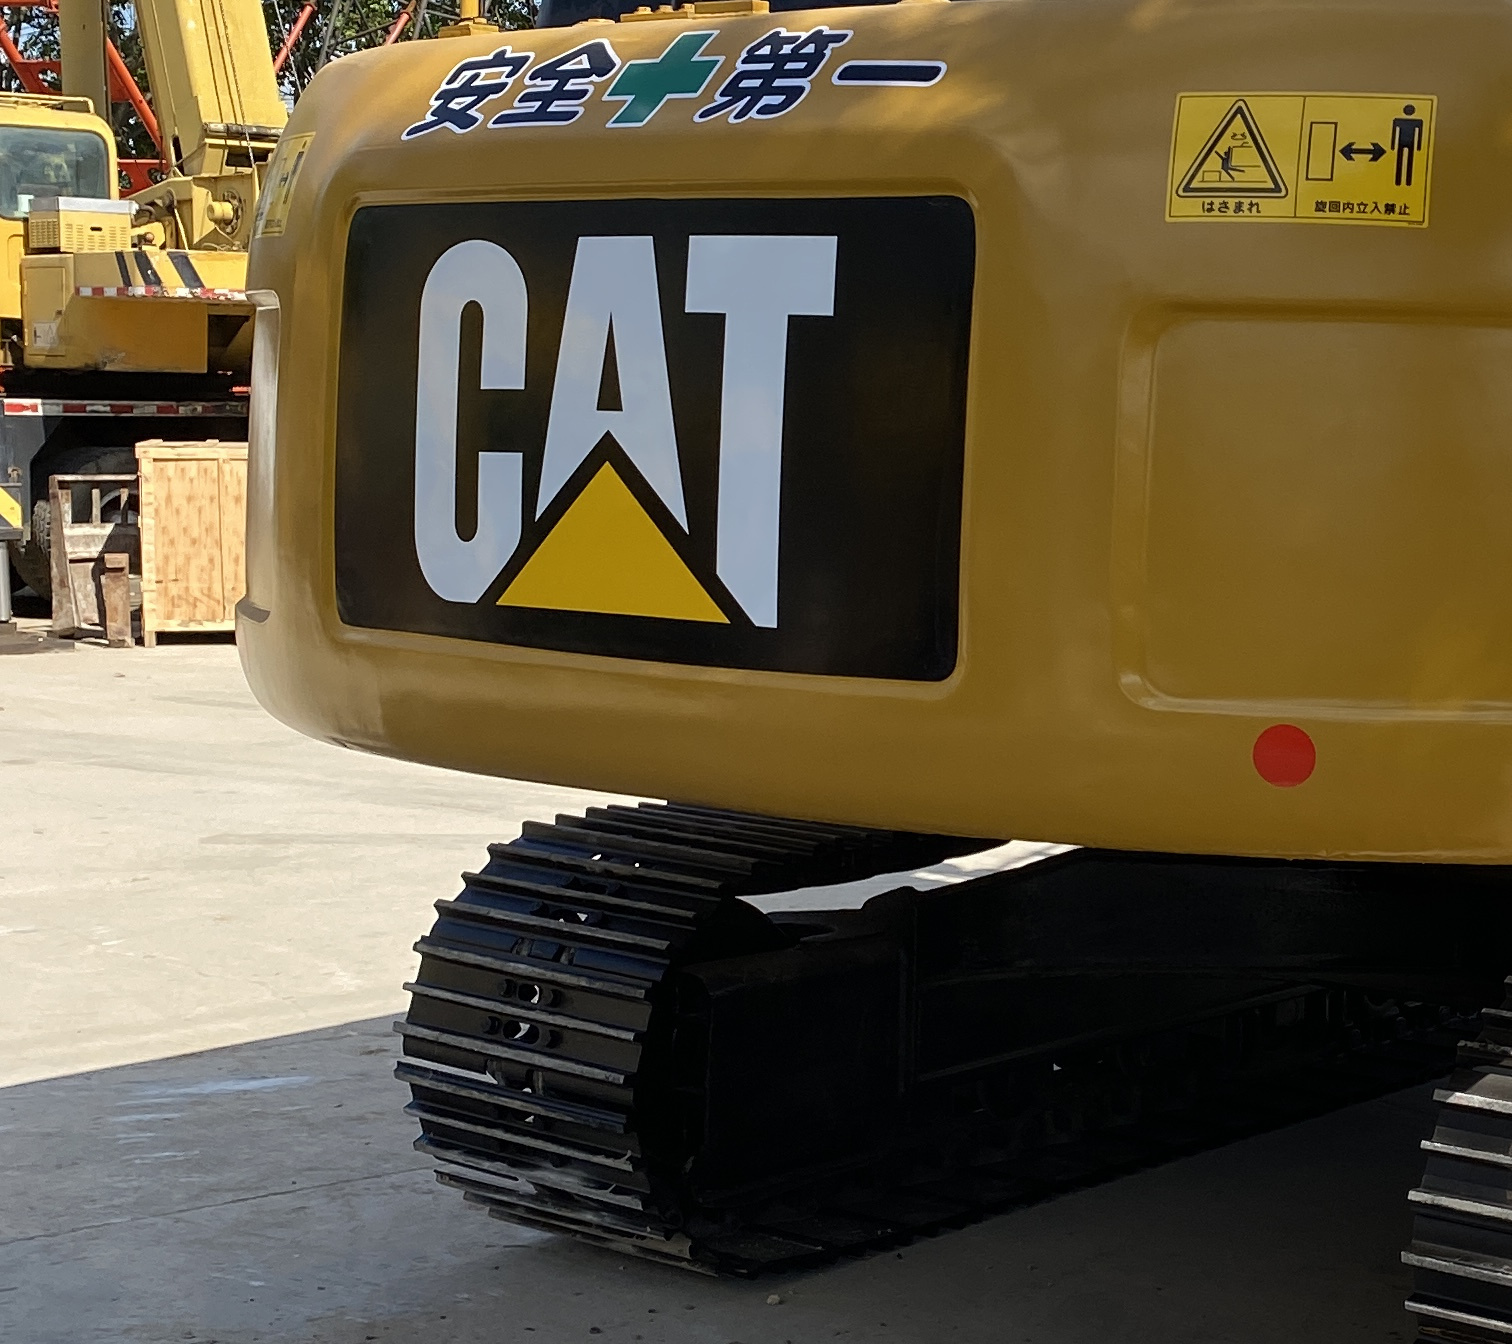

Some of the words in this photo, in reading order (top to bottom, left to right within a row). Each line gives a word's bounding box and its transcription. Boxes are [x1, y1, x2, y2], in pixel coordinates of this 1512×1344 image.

[1201, 199, 1261, 214] はさまれ
[1314, 200, 1411, 217] 旋回内立入禁止
[414, 234, 838, 629] CAT
